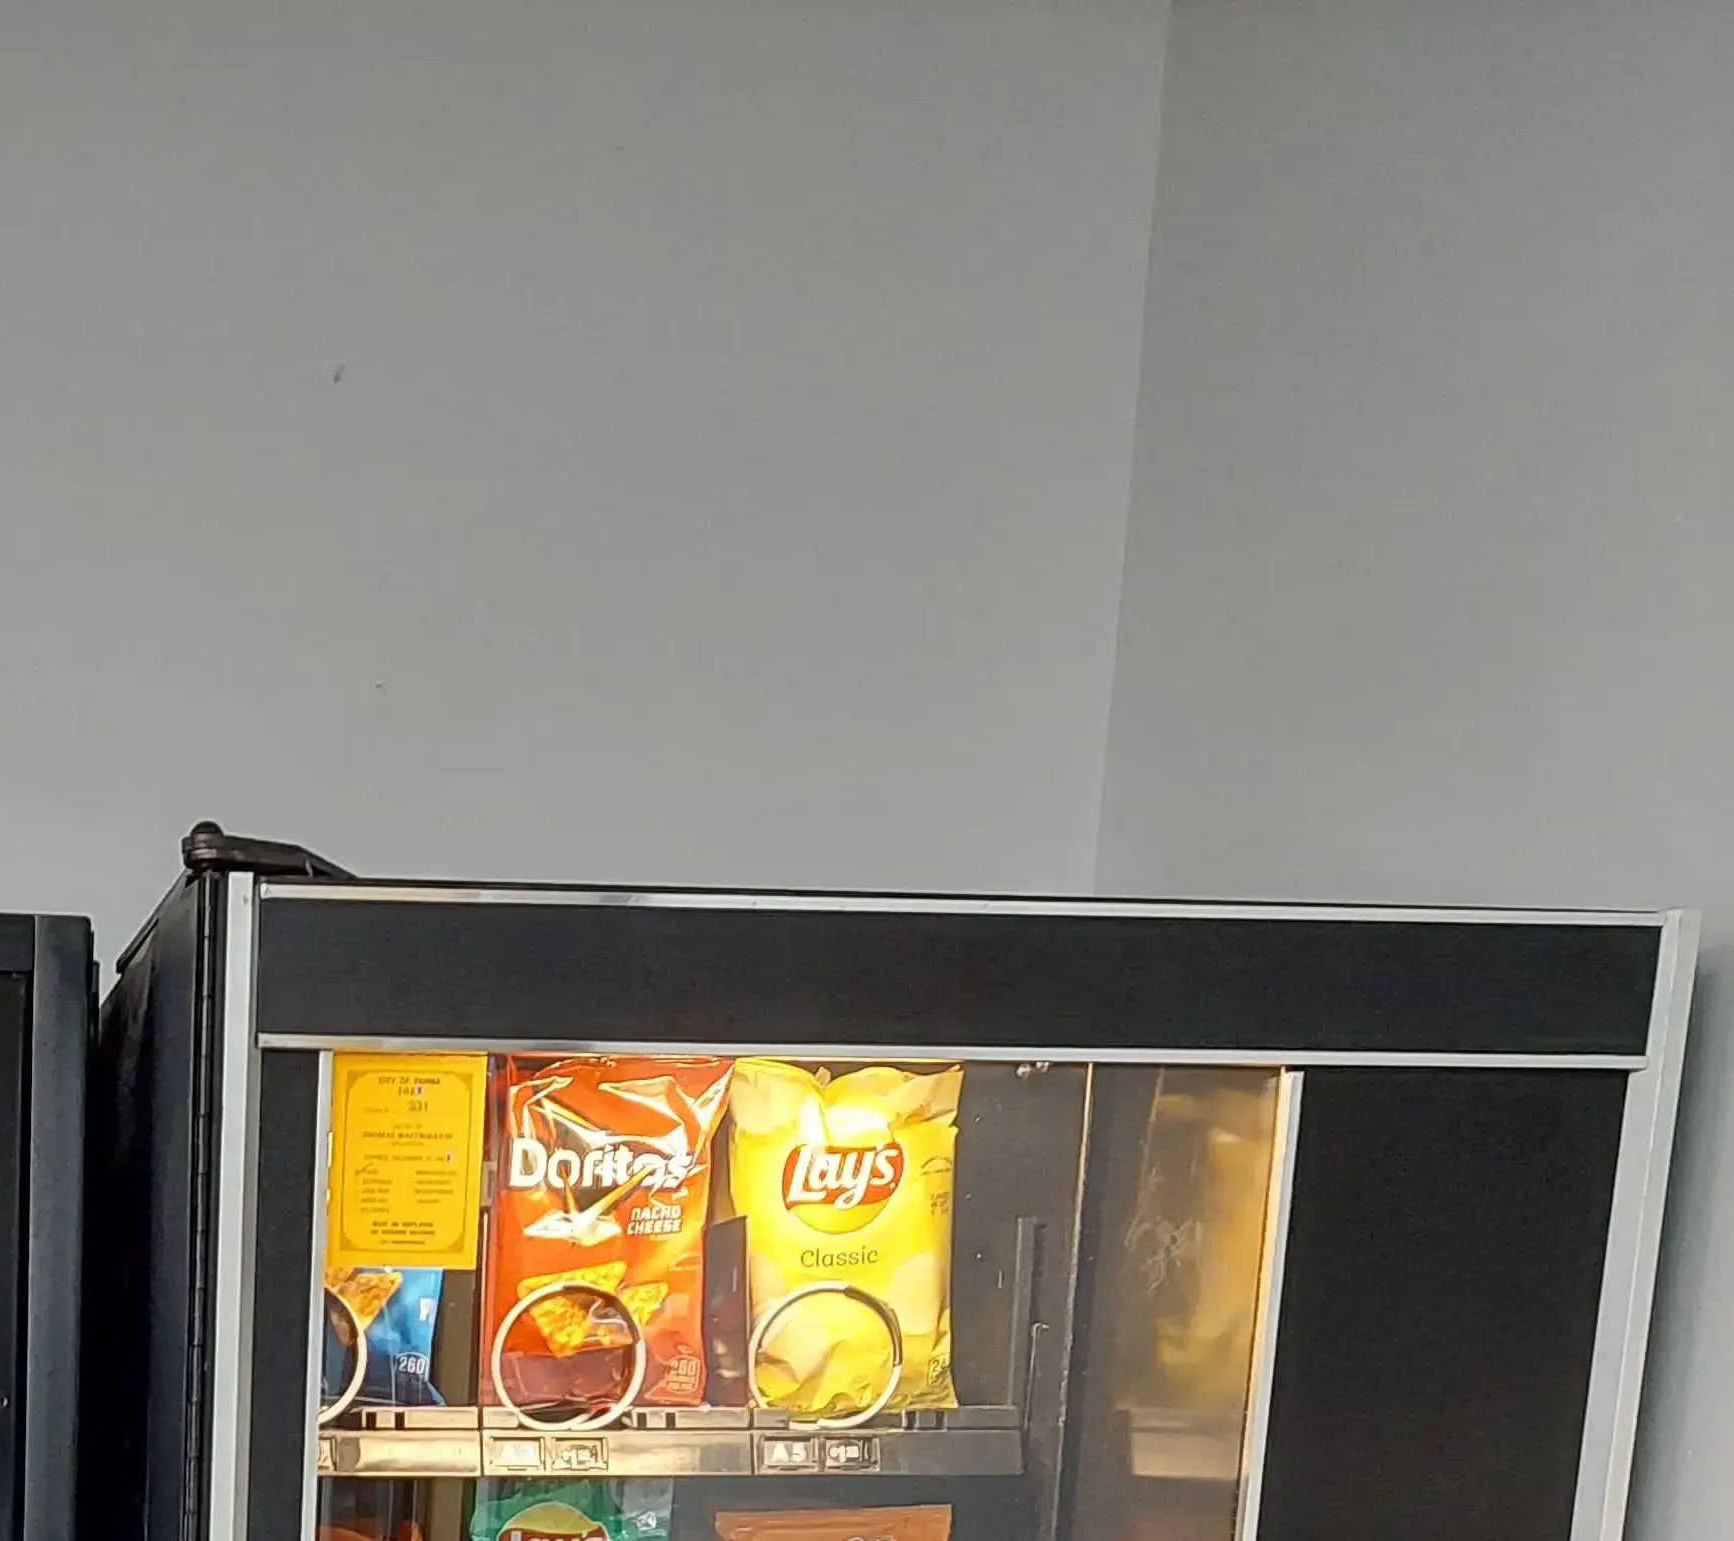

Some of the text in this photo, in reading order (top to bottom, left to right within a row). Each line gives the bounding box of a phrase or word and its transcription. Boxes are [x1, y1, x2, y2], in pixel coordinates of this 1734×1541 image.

[509, 1137, 694, 1190] Doritos
[788, 1143, 897, 1208] Lay's
[630, 1206, 681, 1221] NACHO
[627, 1218, 682, 1235] CHEESE
[801, 1245, 879, 1268] Classic
[398, 1356, 425, 1375] 260
